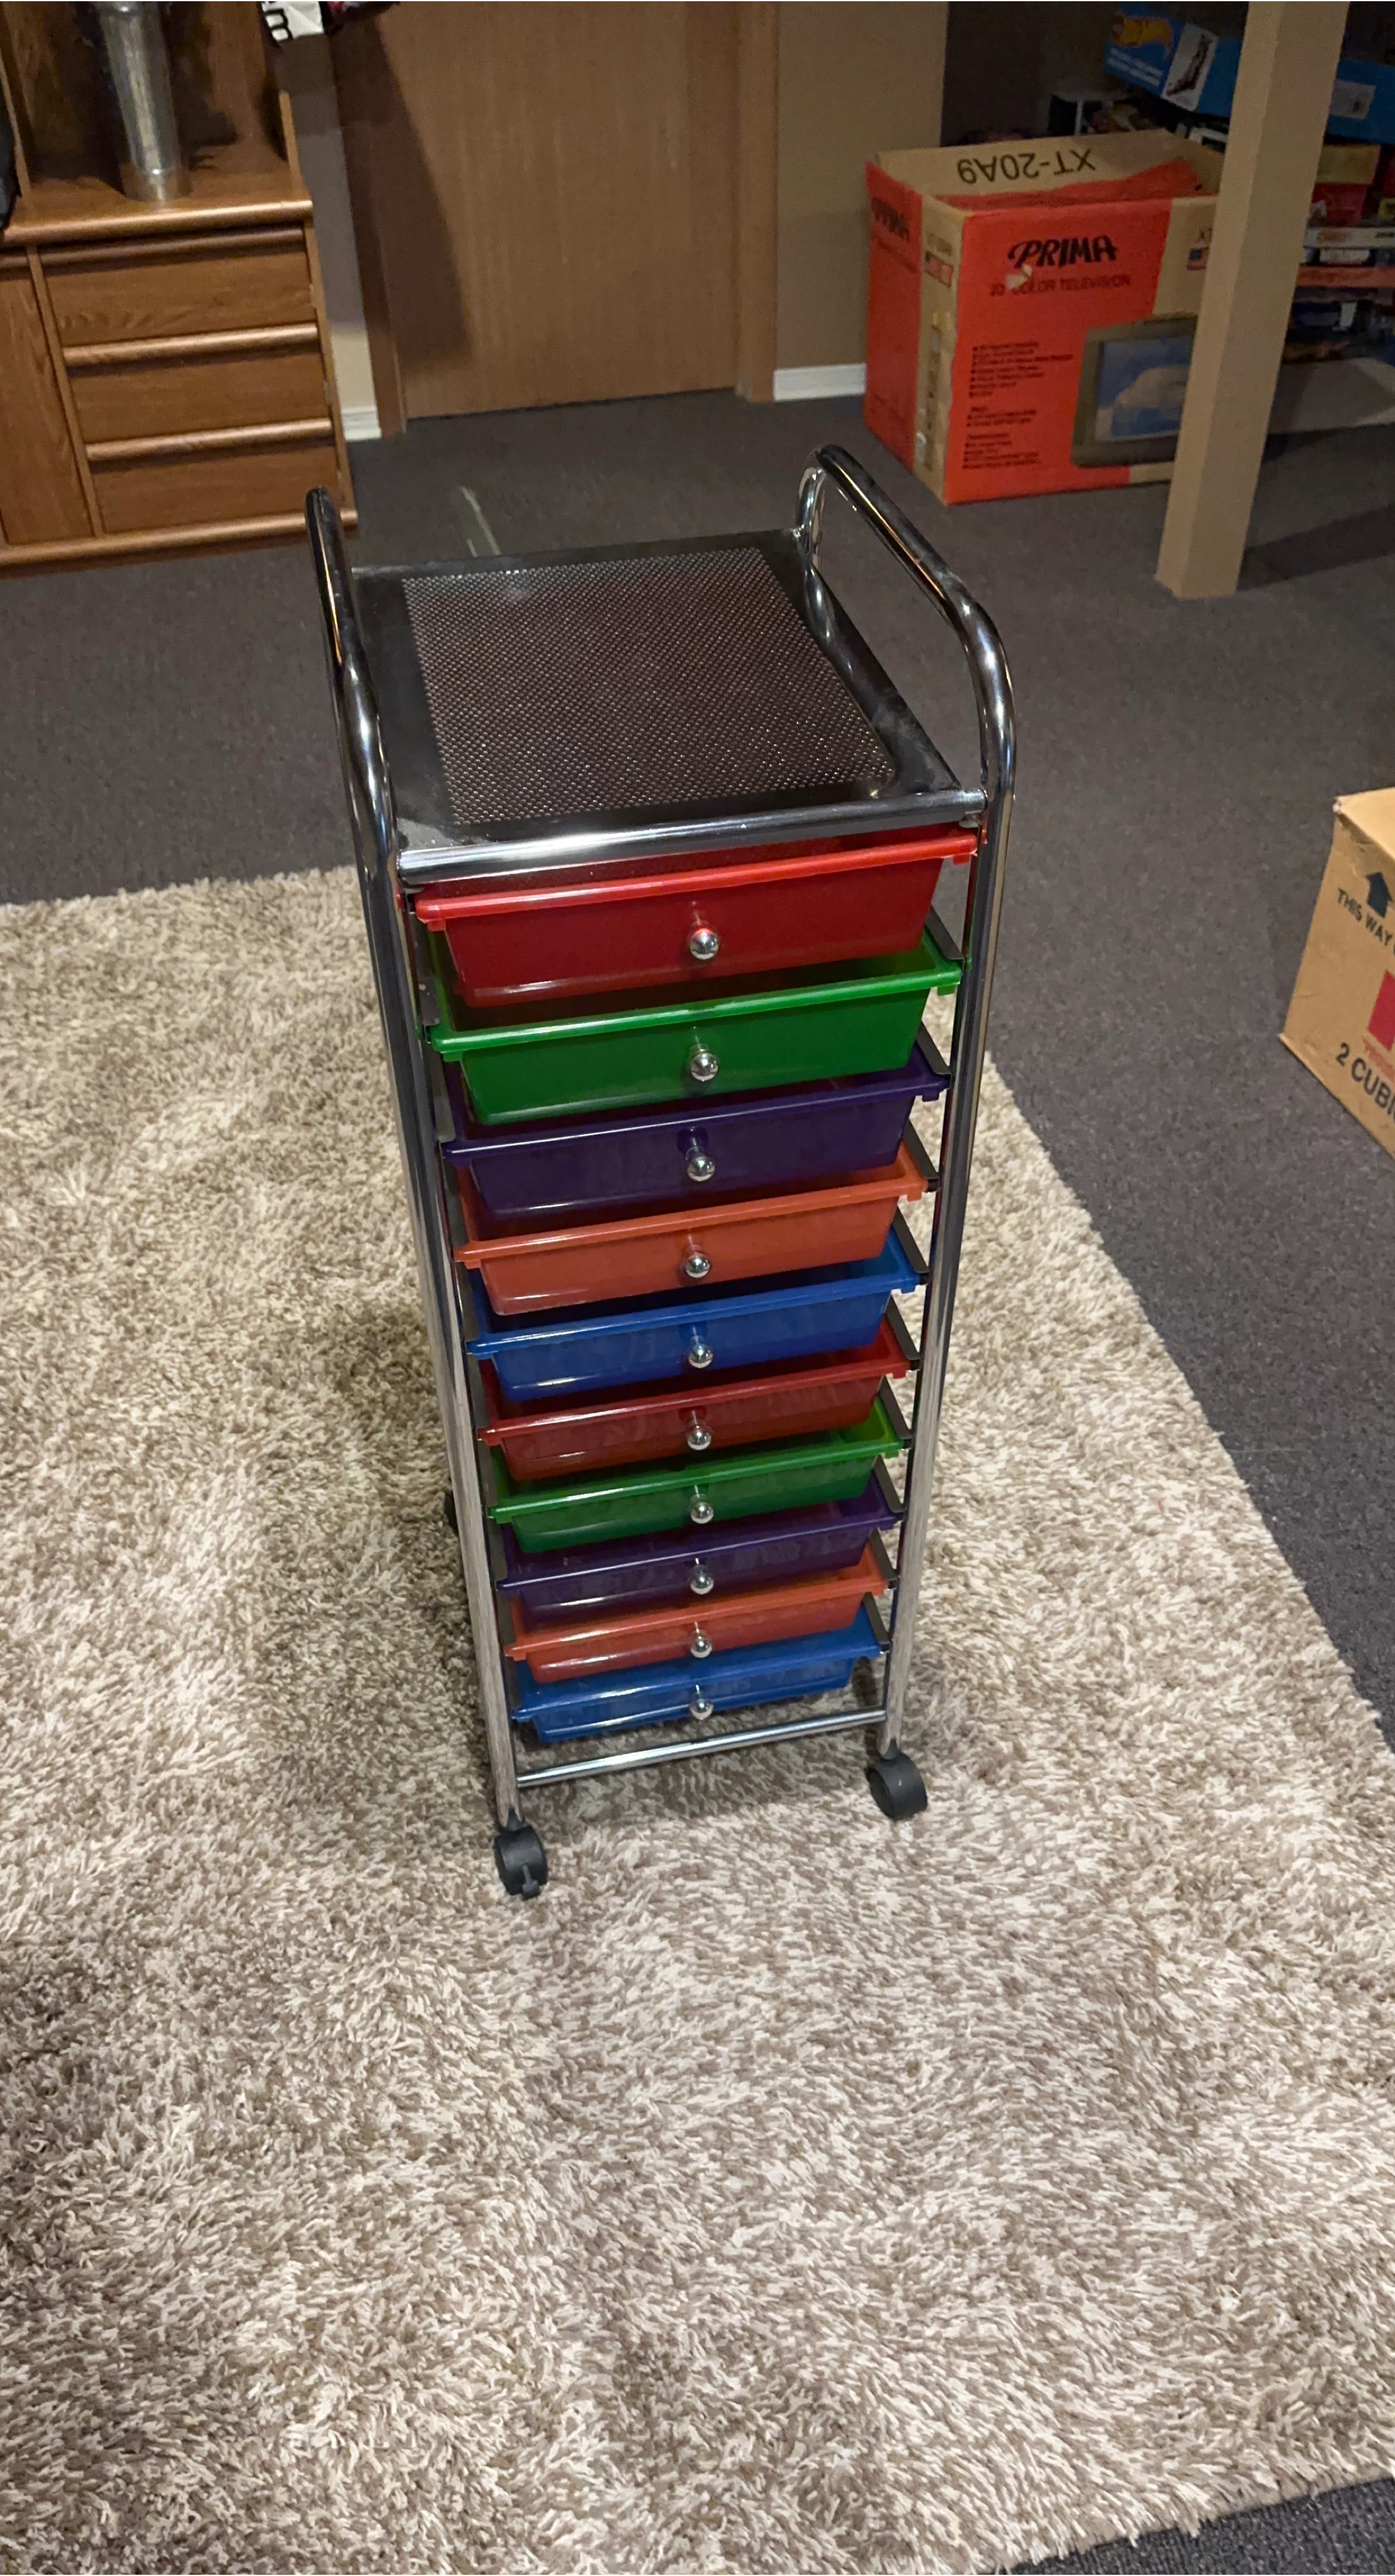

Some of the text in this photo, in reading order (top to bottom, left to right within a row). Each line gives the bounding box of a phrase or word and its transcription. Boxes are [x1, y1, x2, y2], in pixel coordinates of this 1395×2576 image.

[957, 148, 1095, 184] XT-20A9
[1008, 234, 1118, 268] PRIMA
[1059, 274, 1131, 291] TELEVISION
[1338, 887, 1393, 946] THIS WAY
[1336, 1042, 1350, 1067] 2
[1351, 1057, 1395, 1123] CUBI
